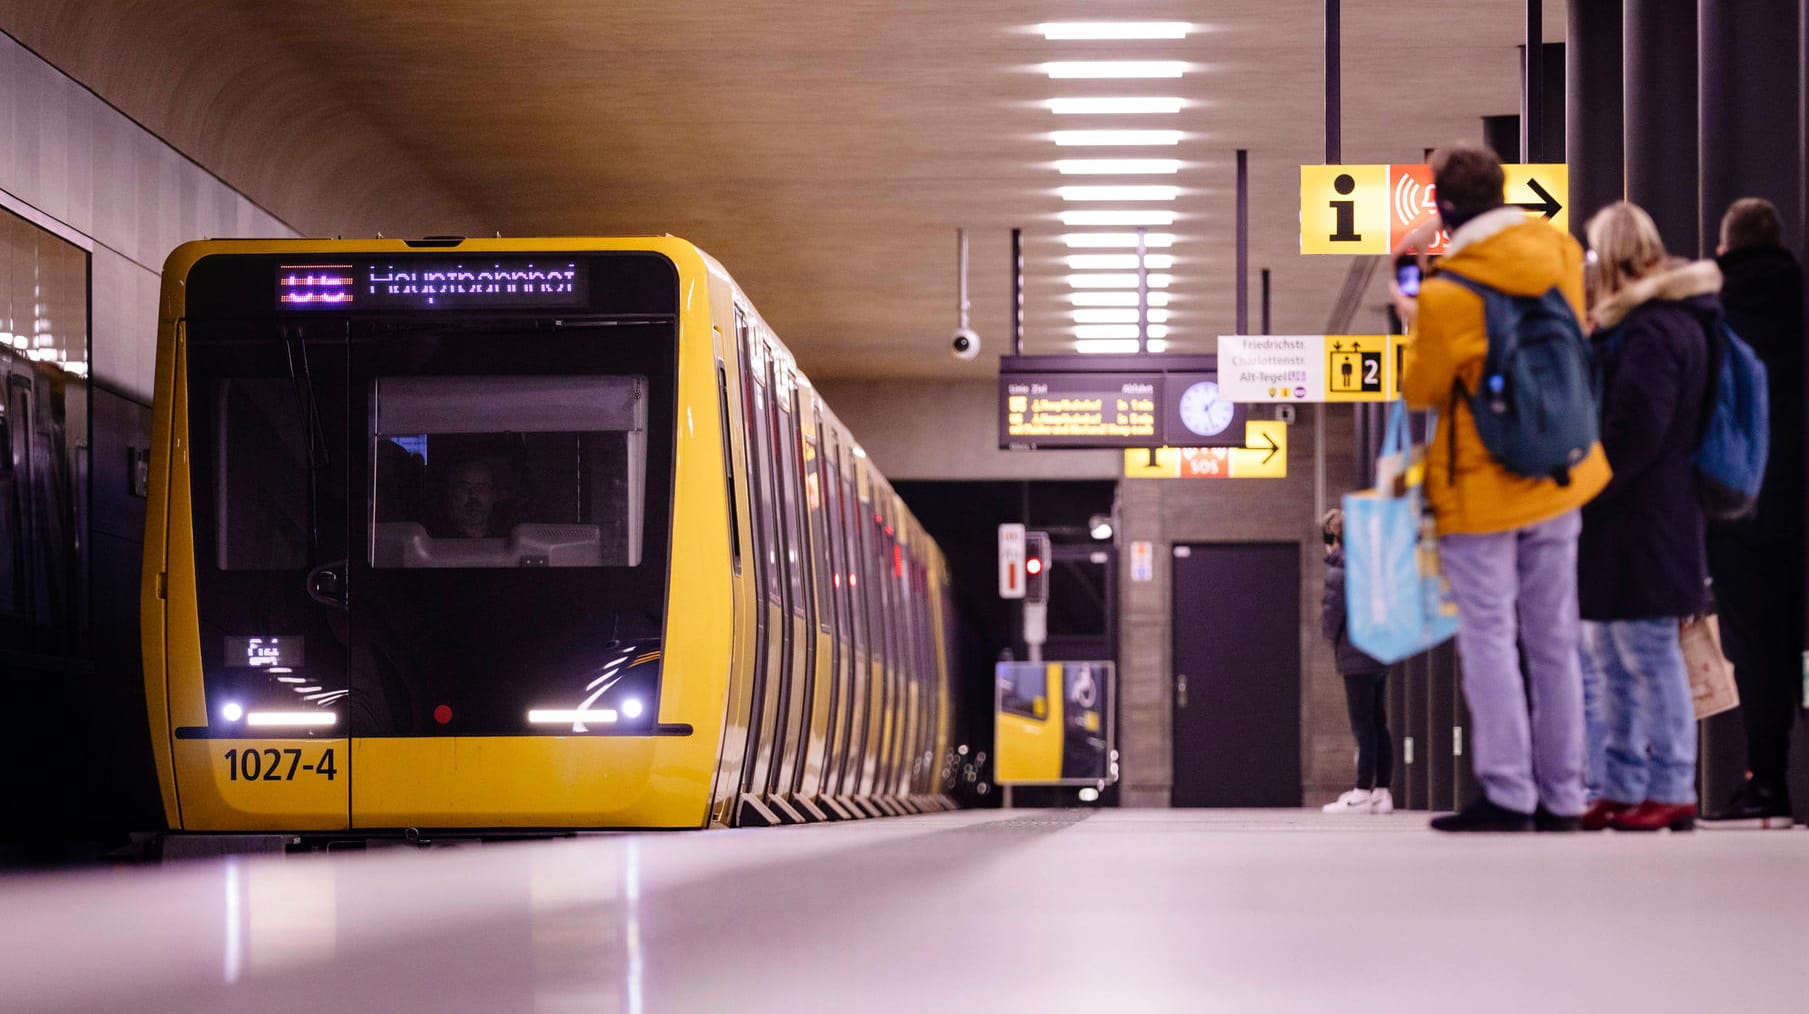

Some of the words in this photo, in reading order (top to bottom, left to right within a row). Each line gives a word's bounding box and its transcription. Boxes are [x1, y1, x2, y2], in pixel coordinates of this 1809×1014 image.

[370, 264, 575, 304] Hauptbahnhof
[1363, 359, 1379, 384] 2
[1190, 458, 1219, 474] SOS
[225, 748, 337, 781] 1027-4
